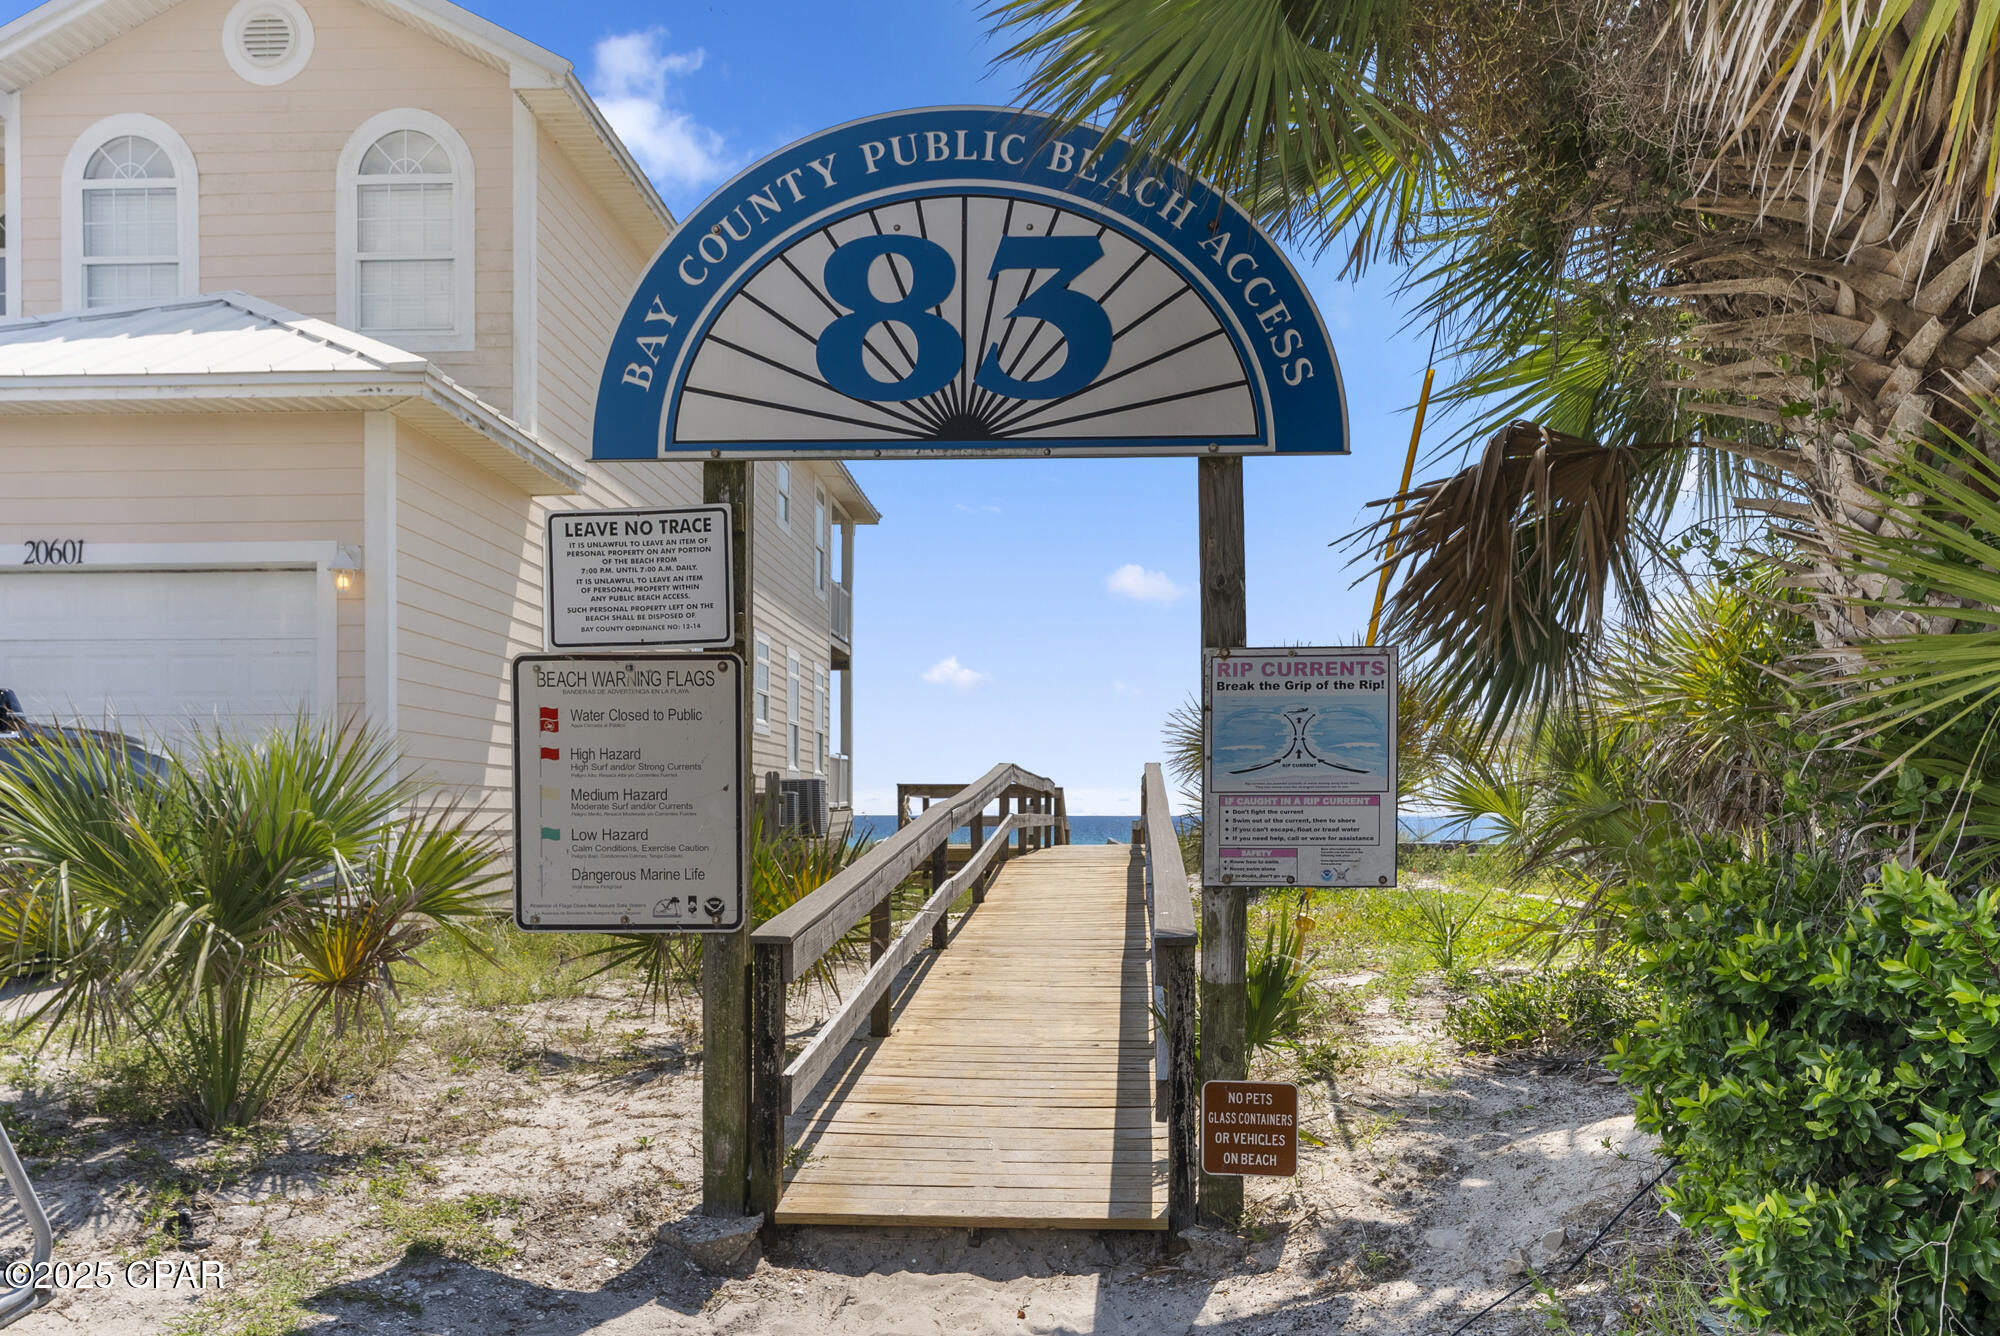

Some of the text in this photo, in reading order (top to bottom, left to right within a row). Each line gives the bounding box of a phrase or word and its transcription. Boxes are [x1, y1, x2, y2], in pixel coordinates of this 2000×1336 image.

[622, 130, 1314, 392] BAY COUNTY PUBLIC BEACH ACCESS
[815, 234, 1114, 402] 83
[565, 518, 712, 538] LEAVE NO TRACE
[23, 538, 84, 565] 20601
[1217, 661, 1386, 677] RIP CURRENTS
[538, 670, 715, 687] BEACH WARNING FLAGS
[1216, 680, 1385, 692] Break the Grip of the Rip!
[570, 708, 702, 722] Water Closed to Public
[570, 748, 640, 764] High Hazard
[570, 764, 588, 772] High
[638, 763, 664, 772] Strong
[571, 788, 668, 801] Medium Hazard
[571, 802, 609, 810] Moderate
[572, 828, 648, 841] Low Hazard
[595, 844, 640, 853] Conditions,
[572, 868, 706, 884] Dangerous Marine Life
[1228, 1092, 1272, 1105] NO PETS
[1208, 1112, 1292, 1126] GLASS CONTAINERS
[1215, 1132, 1286, 1146] OR VEHICLES
[1224, 1153, 1276, 1166] ON BEACH
